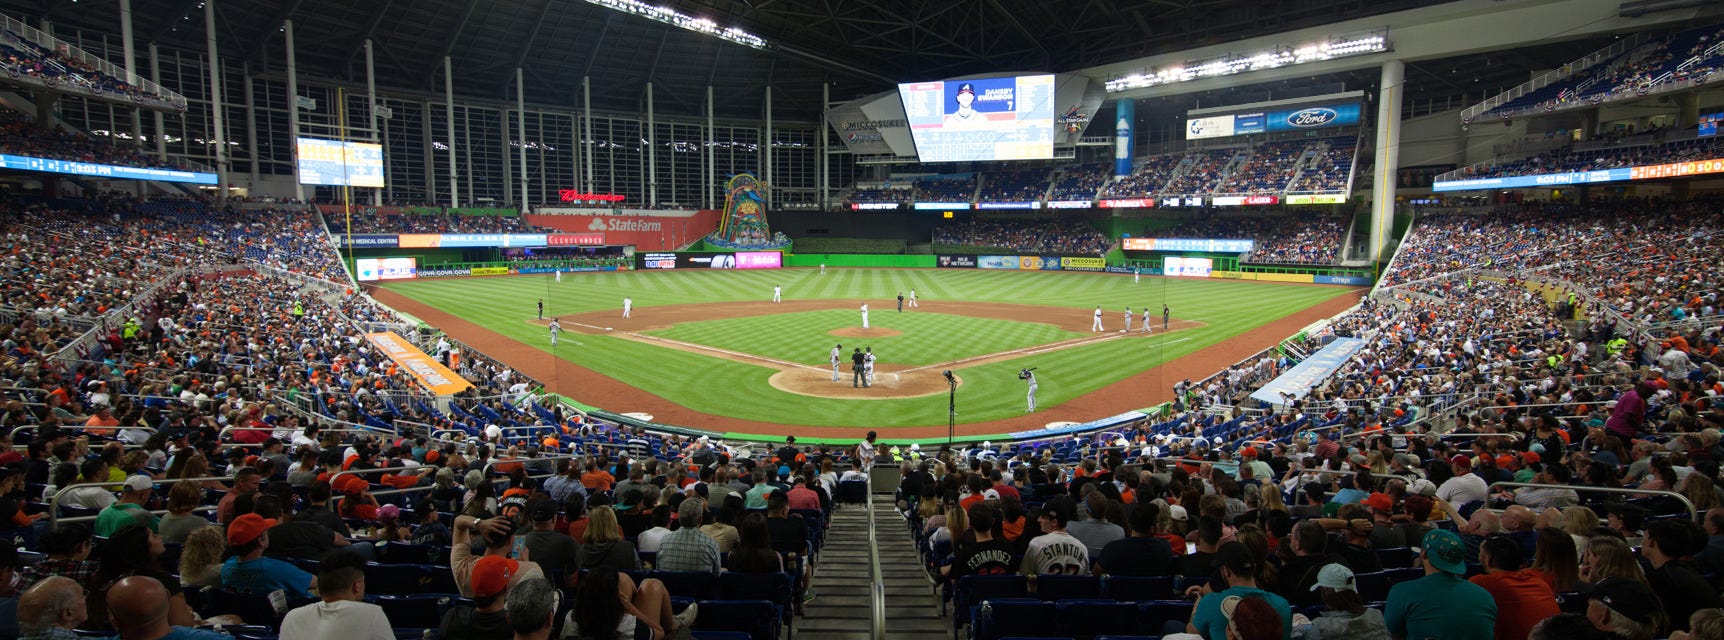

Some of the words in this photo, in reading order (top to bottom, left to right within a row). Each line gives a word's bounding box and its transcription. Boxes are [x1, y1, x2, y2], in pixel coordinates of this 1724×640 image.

[1007, 101, 1013, 111] 7
[1296, 111, 1327, 124] Ford
[849, 119, 906, 129] MICCOSUKEE
[76, 164, 96, 174] 9:03
[98, 166, 111, 175] PM
[1536, 176, 1554, 184] 9:03
[1556, 175, 1569, 183] PM
[559, 189, 625, 202] Budweiser
[548, 235, 603, 245] CLEVELANDER
[1043, 543, 1086, 564] STANTON
[967, 549, 1012, 570] FERNANDEZ
